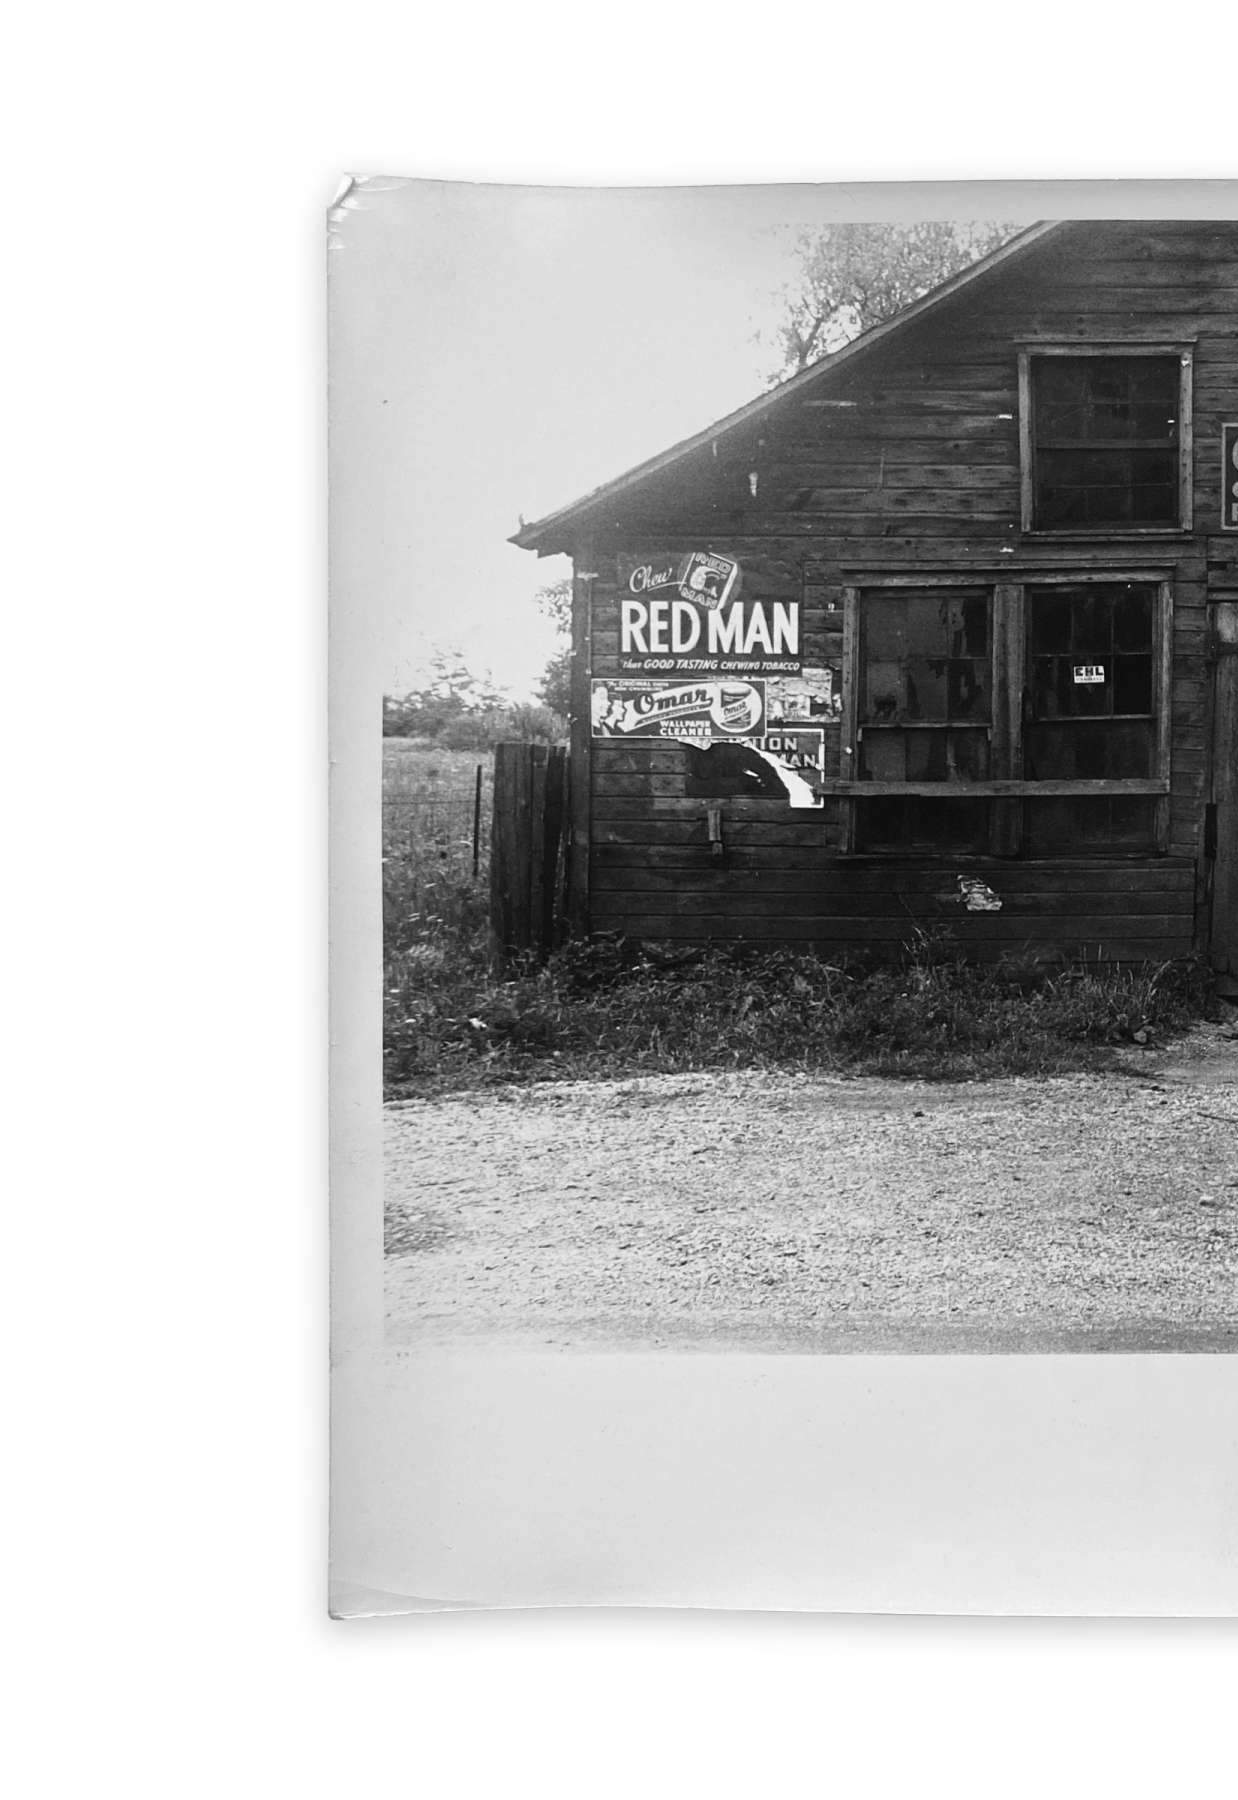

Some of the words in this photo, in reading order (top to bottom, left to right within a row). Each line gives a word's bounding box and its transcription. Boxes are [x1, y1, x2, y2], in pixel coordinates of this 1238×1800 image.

[629, 566, 673, 593] Chew
[621, 600, 701, 653] RED
[708, 602, 799, 655] MAN
[643, 659, 674, 669] GOOD
[676, 659, 718, 670] TASTING
[720, 660, 759, 670] CHEWING
[761, 661, 800, 671] TOBACCO
[633, 689, 714, 715] Omar
[660, 720, 711, 728] WALLPAPER
[660, 728, 712, 736] CLEANER
